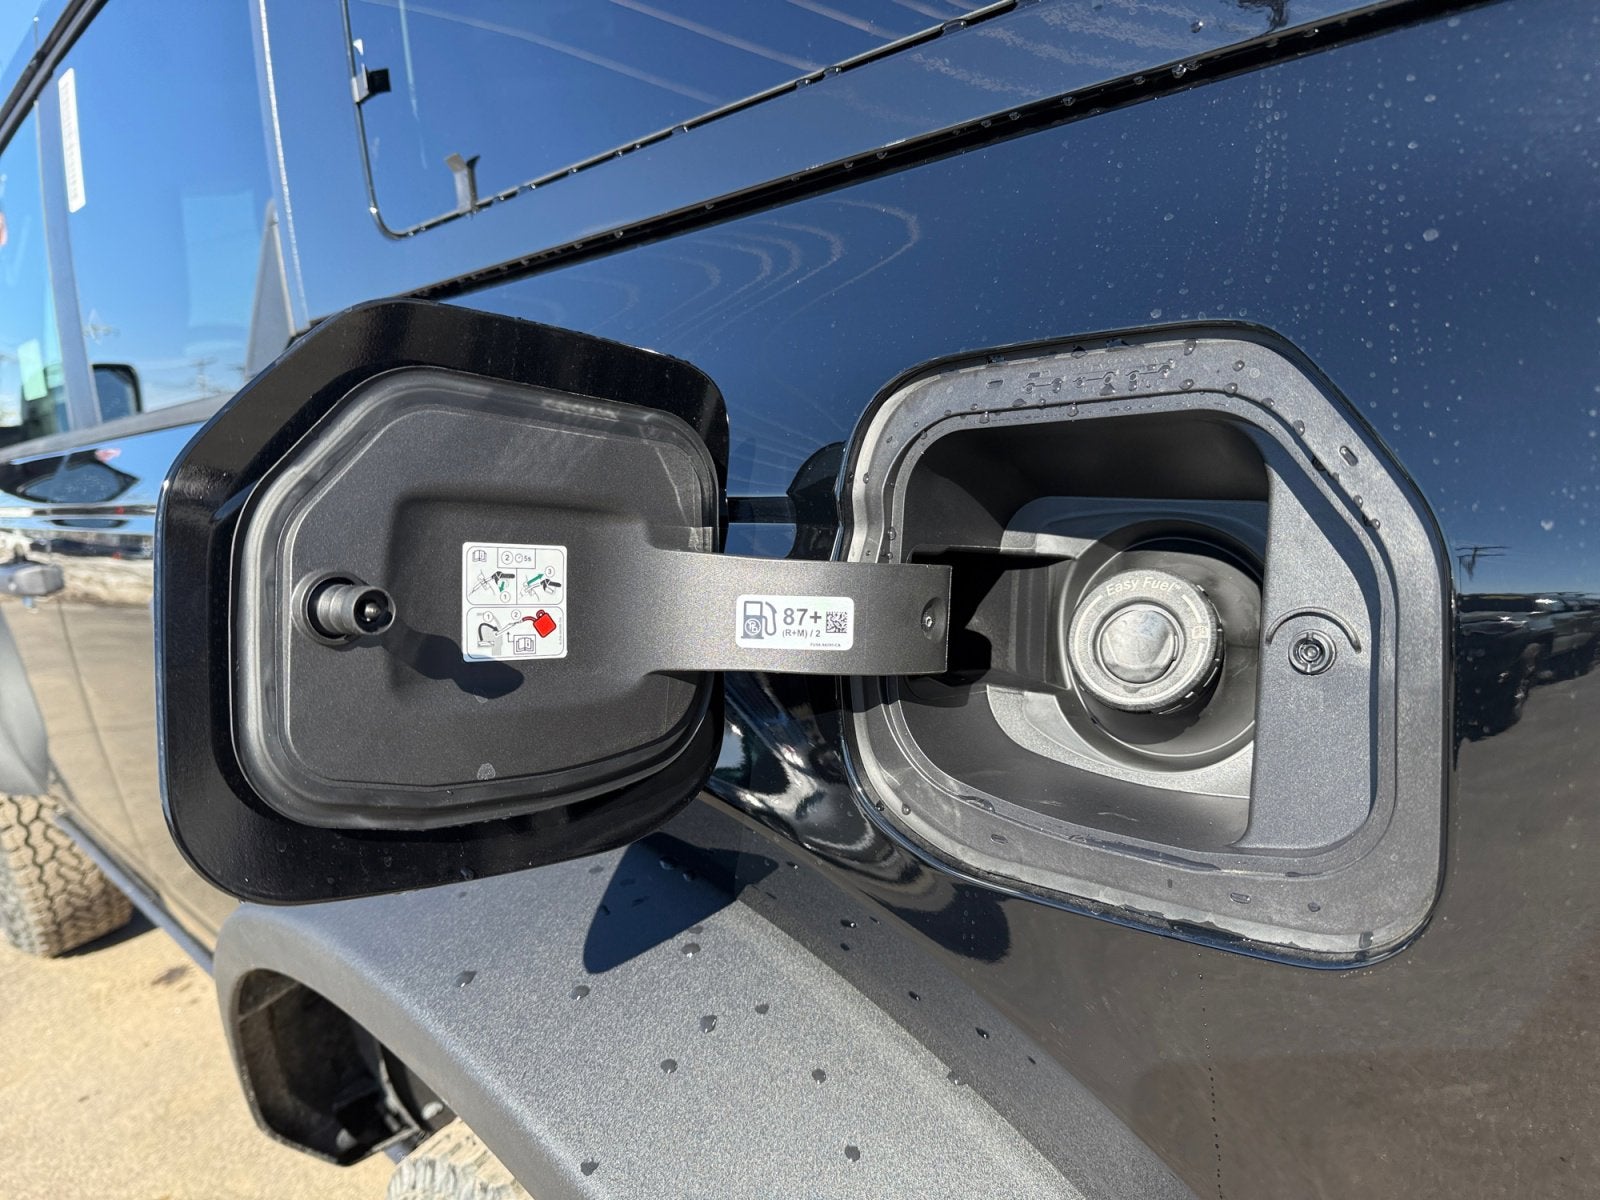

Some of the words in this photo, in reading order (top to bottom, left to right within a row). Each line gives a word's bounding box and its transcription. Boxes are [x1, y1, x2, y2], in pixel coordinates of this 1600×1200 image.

[1106, 579, 1139, 596] Easy
[783, 607, 822, 626] 87+
[782, 629, 808, 639] (R+M)
